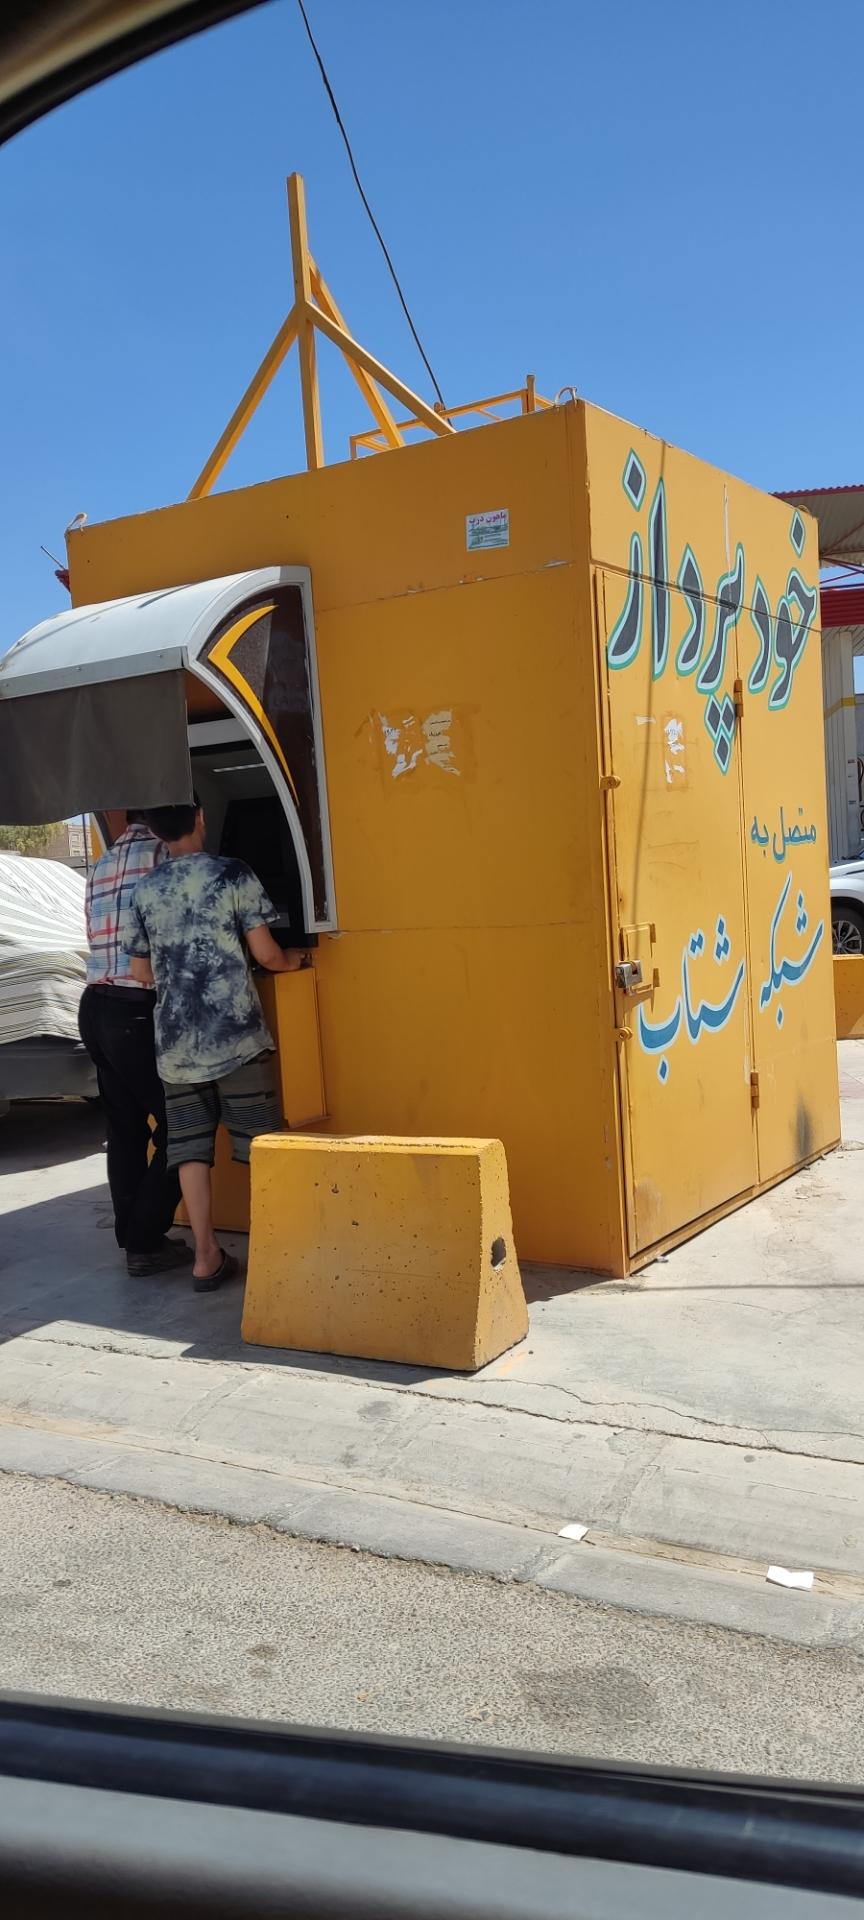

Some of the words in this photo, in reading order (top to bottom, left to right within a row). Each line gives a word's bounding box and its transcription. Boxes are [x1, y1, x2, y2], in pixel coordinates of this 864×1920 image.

[607, 447, 745, 776] پرداز
[749, 510, 817, 711] خود
[750, 816, 769, 858] به
[771, 806, 817, 863] متصل
[637, 913, 745, 1085] شتاب
[758, 870, 825, 1029] شبکه
